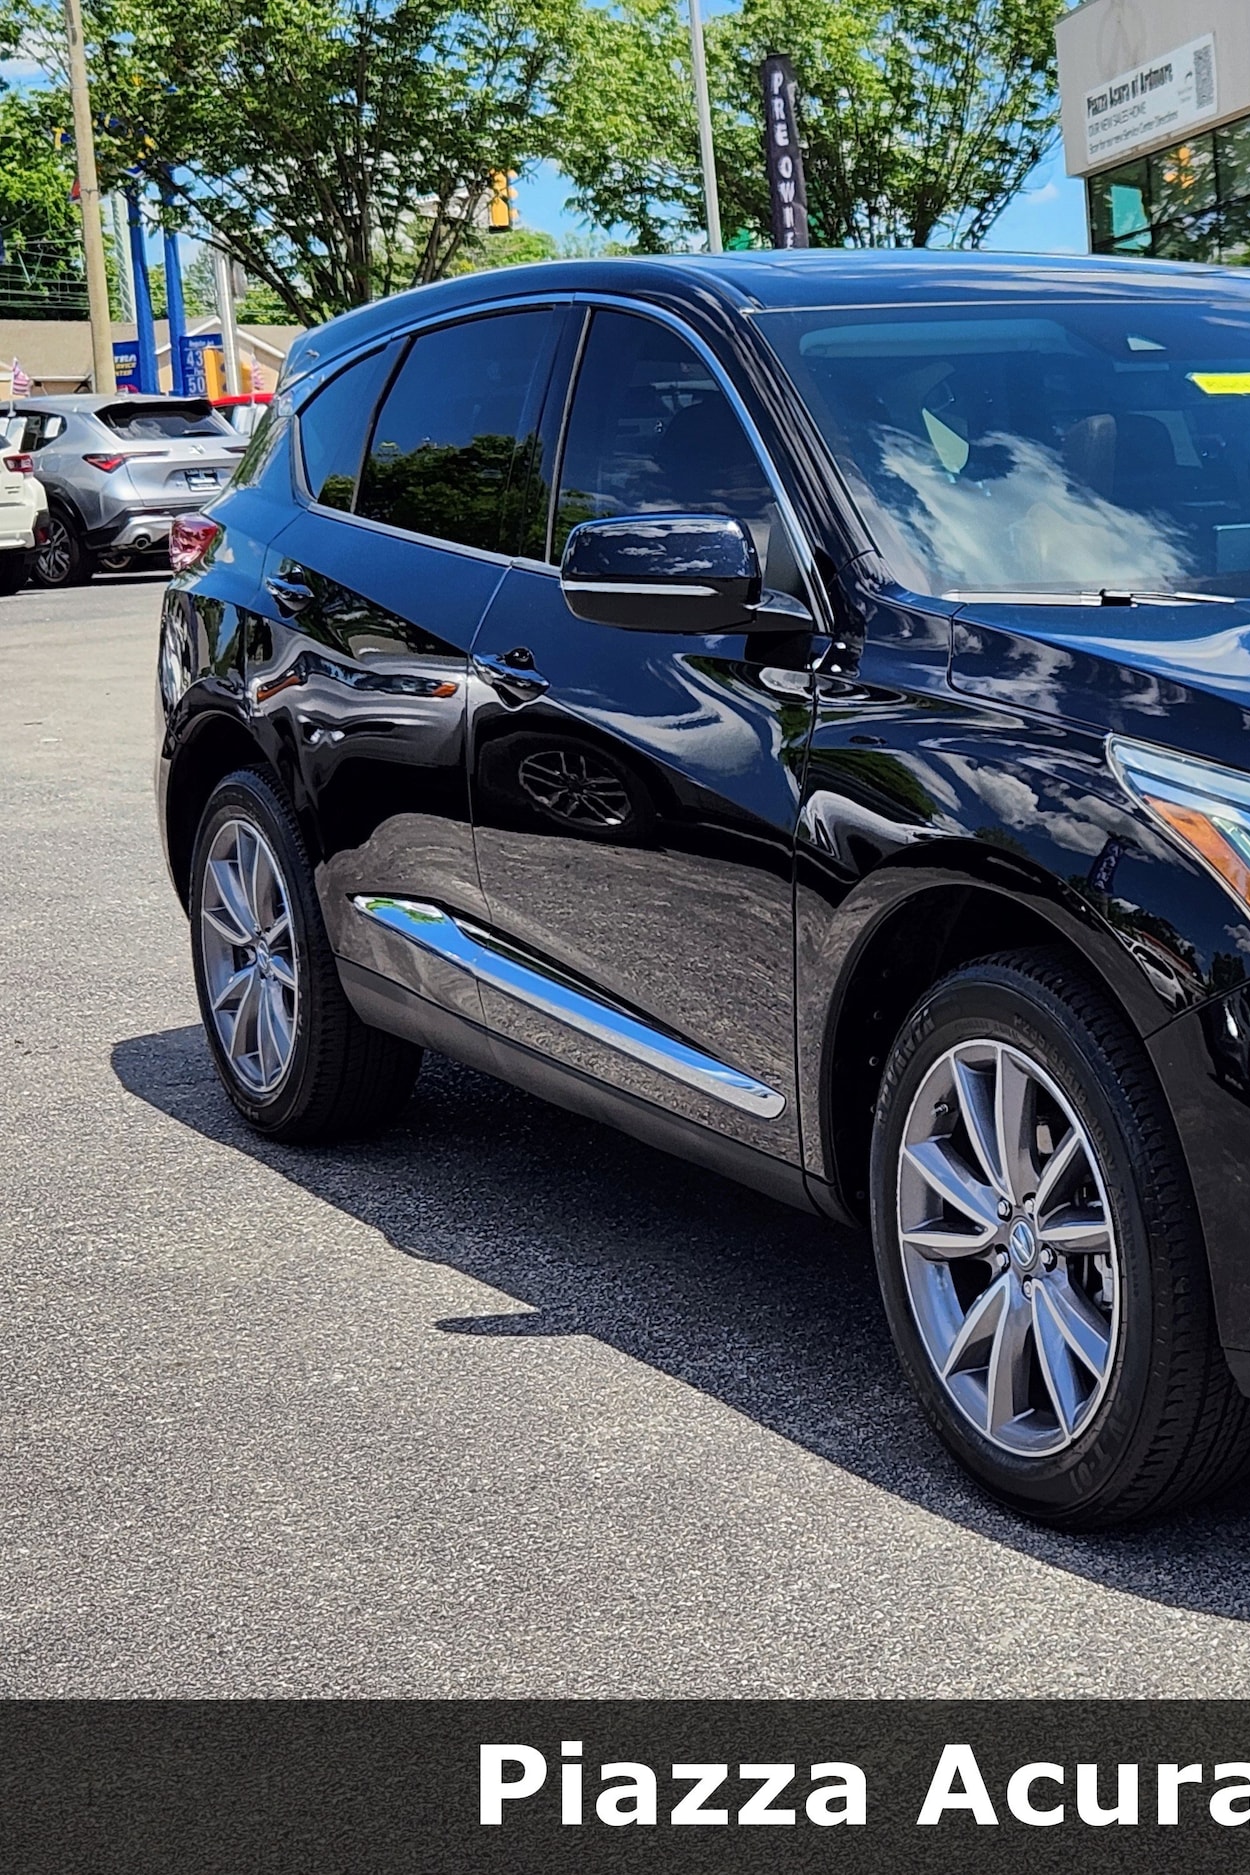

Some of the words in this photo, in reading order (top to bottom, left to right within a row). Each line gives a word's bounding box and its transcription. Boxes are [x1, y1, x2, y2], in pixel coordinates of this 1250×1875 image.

[770, 70, 790, 147] PRE
[777, 154, 797, 250] OWNE
[186, 351, 203, 367] 43
[189, 377, 205, 393] 50
